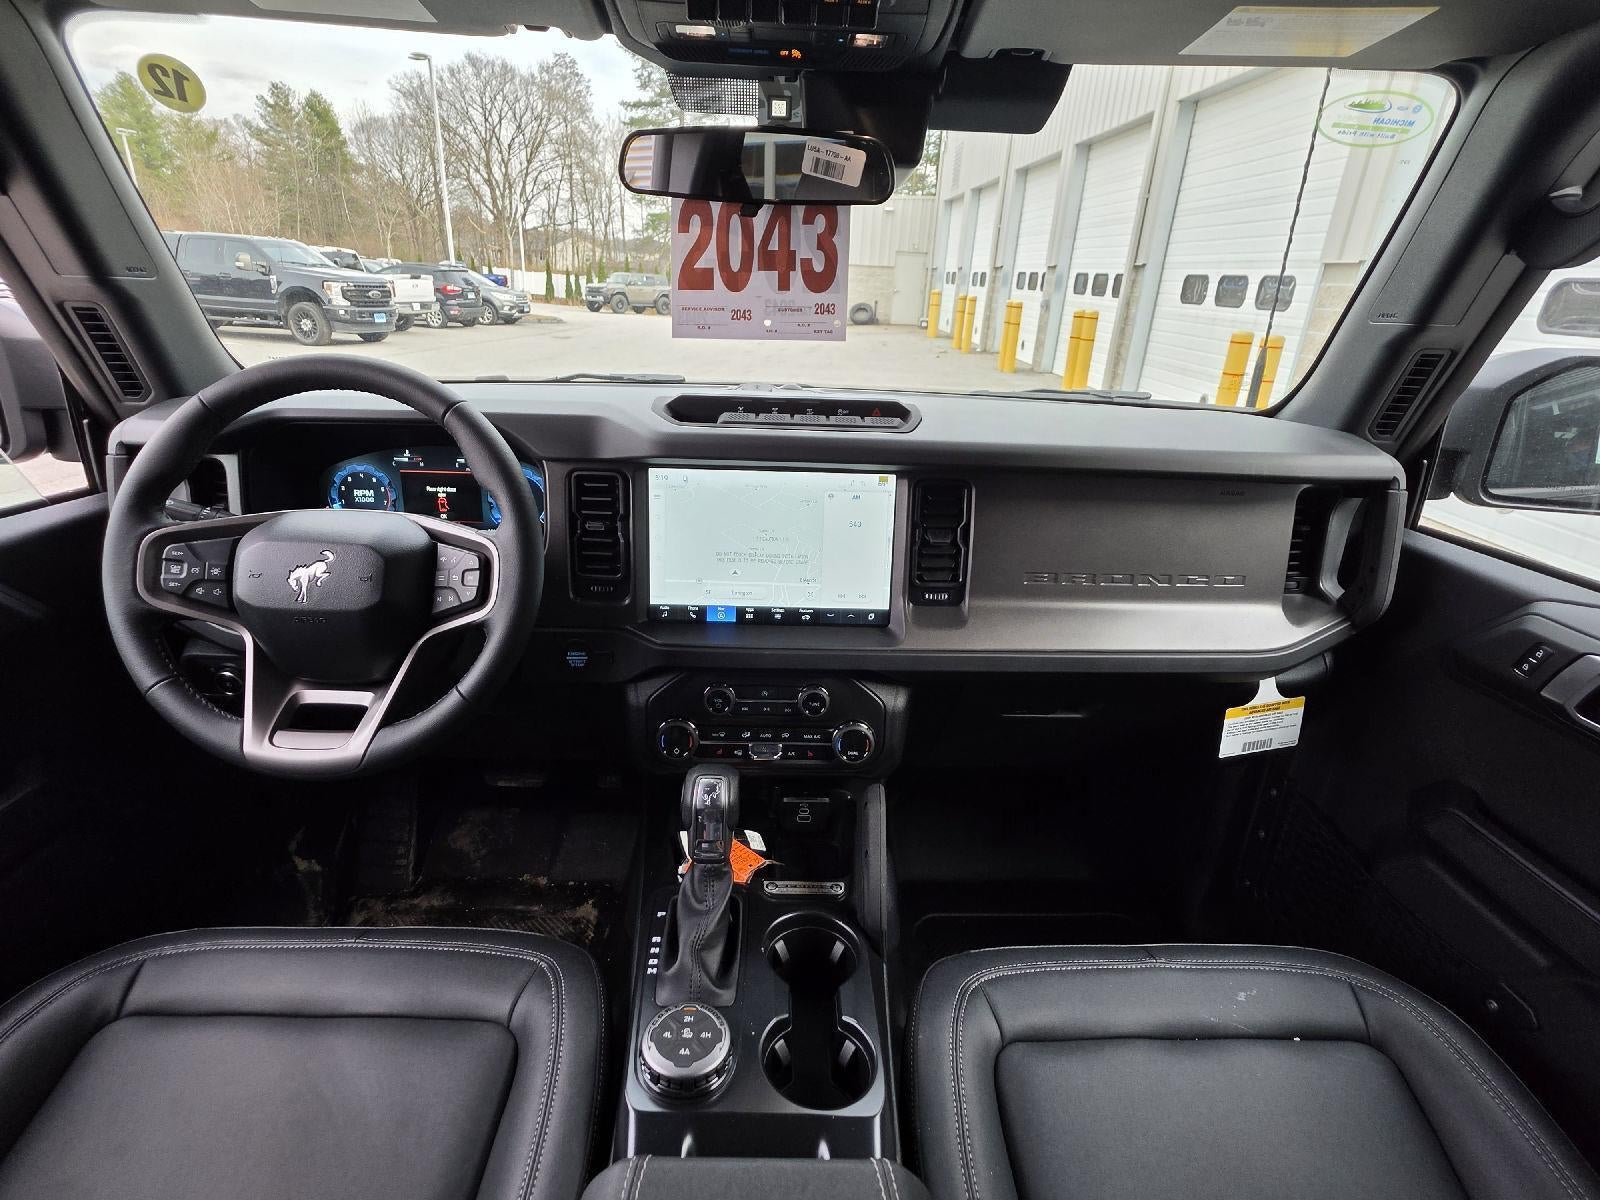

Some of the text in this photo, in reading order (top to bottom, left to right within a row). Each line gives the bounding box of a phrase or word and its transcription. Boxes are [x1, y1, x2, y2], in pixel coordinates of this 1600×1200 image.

[677, 198, 839, 294] 2043
[814, 302, 836, 315] 2043
[730, 308, 752, 321] 2043
[353, 489, 374, 497] RPM
[1024, 571, 1246, 587] BRONCO
[646, 967, 658, 975] M
[700, 1031, 712, 1039] 4H
[678, 1047, 690, 1055] 4A
